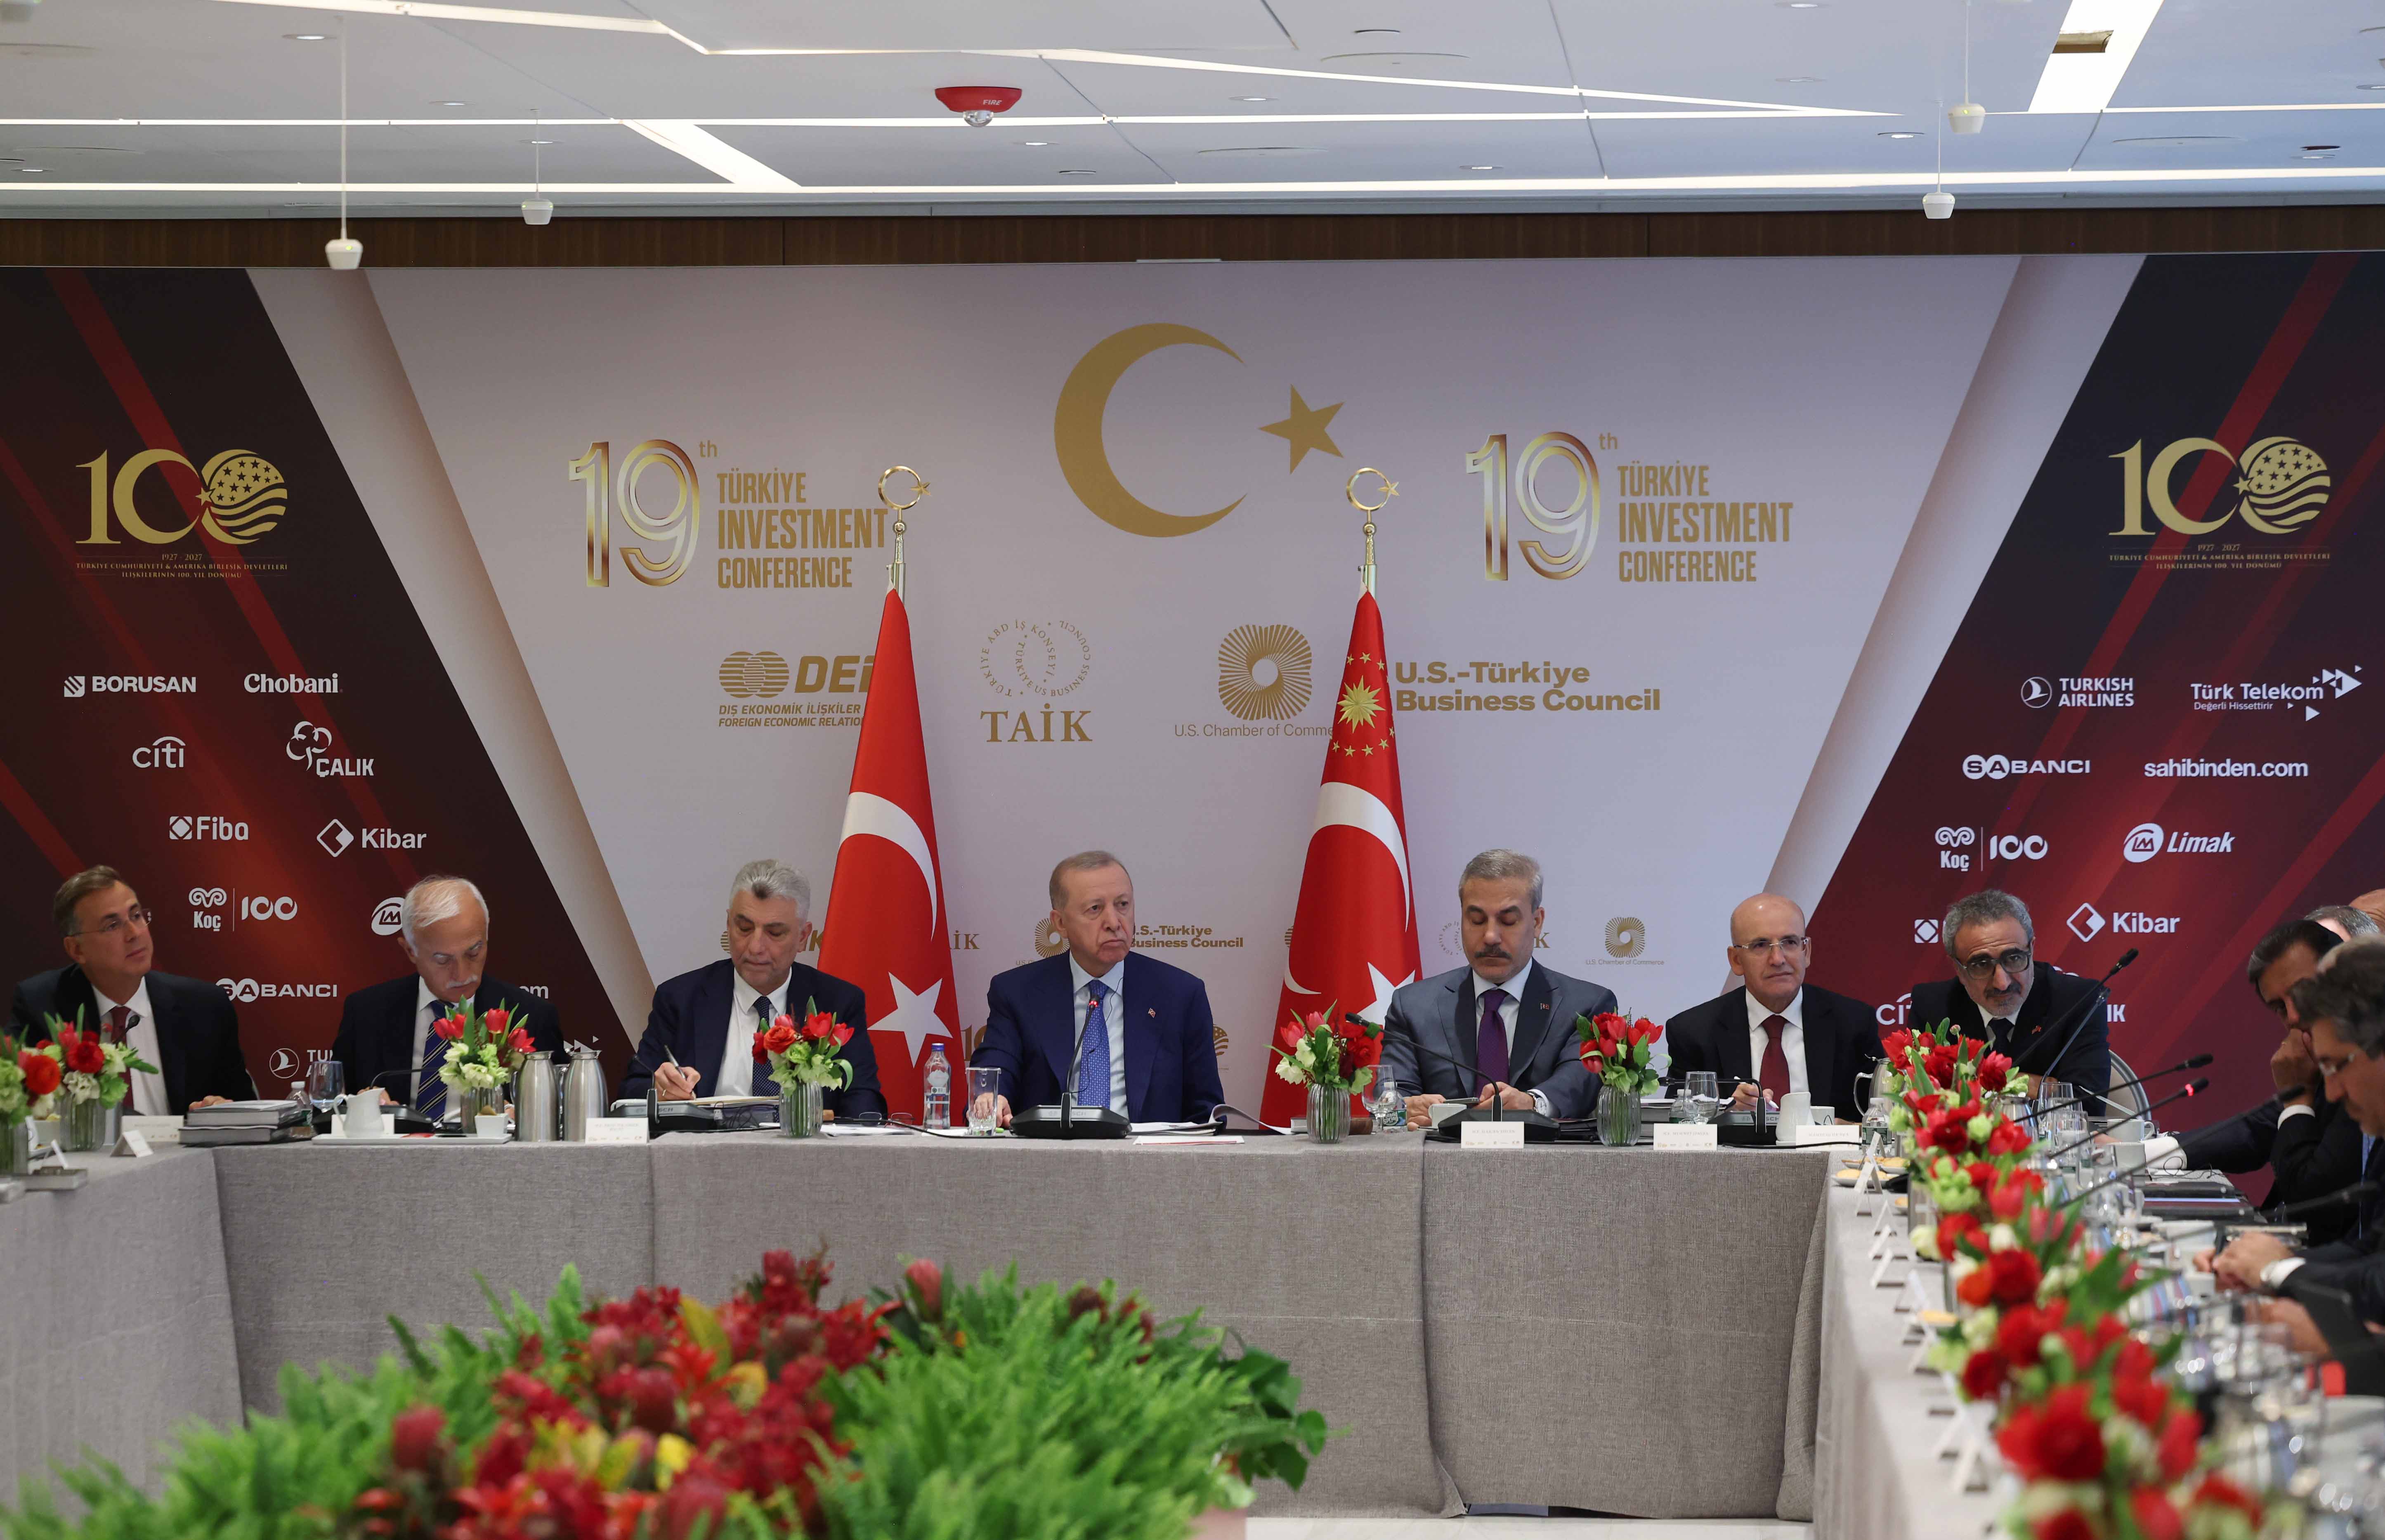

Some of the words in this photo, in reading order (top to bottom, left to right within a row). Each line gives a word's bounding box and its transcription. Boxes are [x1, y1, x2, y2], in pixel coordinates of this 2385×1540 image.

[717, 468, 806, 503] TÜRKİYE
[1618, 461, 1709, 496] TÜRKİYE
[718, 508, 888, 549] INVESTMENT
[1619, 502, 1793, 543] INVESTMENT
[718, 557, 852, 588] CONFERENCE
[1619, 551, 1757, 582] CONFERENCE
[1059, 620, 1091, 661] COUNCIL
[92, 676, 196, 692] BORUSAN
[244, 673, 338, 693] Chobani
[1050, 664, 1090, 697] BUSINESS
[1396, 661, 1590, 688] U.S.-Türkiye
[2059, 678, 2133, 691] TURKISH
[1396, 689, 1535, 711] Business
[1542, 689, 1660, 711] Council
[2058, 693, 2134, 707] AIRLINES
[2190, 683, 2234, 700] Türk
[2240, 683, 2324, 700] Telekom
[719, 705, 737, 717] DIŞ
[741, 702, 803, 715] EKONOMİK
[807, 702, 861, 716] İLİŞKİLER
[2194, 702, 2227, 711] Değerli
[2229, 702, 2274, 710] Hissettirir
[719, 718, 762, 727] FOREIGN
[764, 717, 817, 727] ECONOMIC
[819, 717, 863, 727] RELATIO
[980, 703, 1093, 742] TAİK
[1175, 724, 1199, 737] U.S.
[1203, 724, 1264, 737] Chamber
[1267, 723, 1281, 736] of
[132, 736, 186, 768] citi
[316, 758, 374, 777] ÇALIK
[1963, 756, 2090, 778] SABANCI
[2144, 758, 2308, 777] sahibinden.com
[197, 816, 248, 841] Fiba
[362, 828, 427, 849] Kibar
[1990, 835, 2048, 860] 100
[2167, 831, 2235, 853] Limak
[1941, 850, 1969, 872] Koç
[241, 896, 298, 921] 100
[194, 911, 221, 932] Koç
[1133, 925, 1212, 938] .S.-Türkiye
[2113, 912, 2180, 933] Kibar
[1191, 937, 1243, 948] Council
